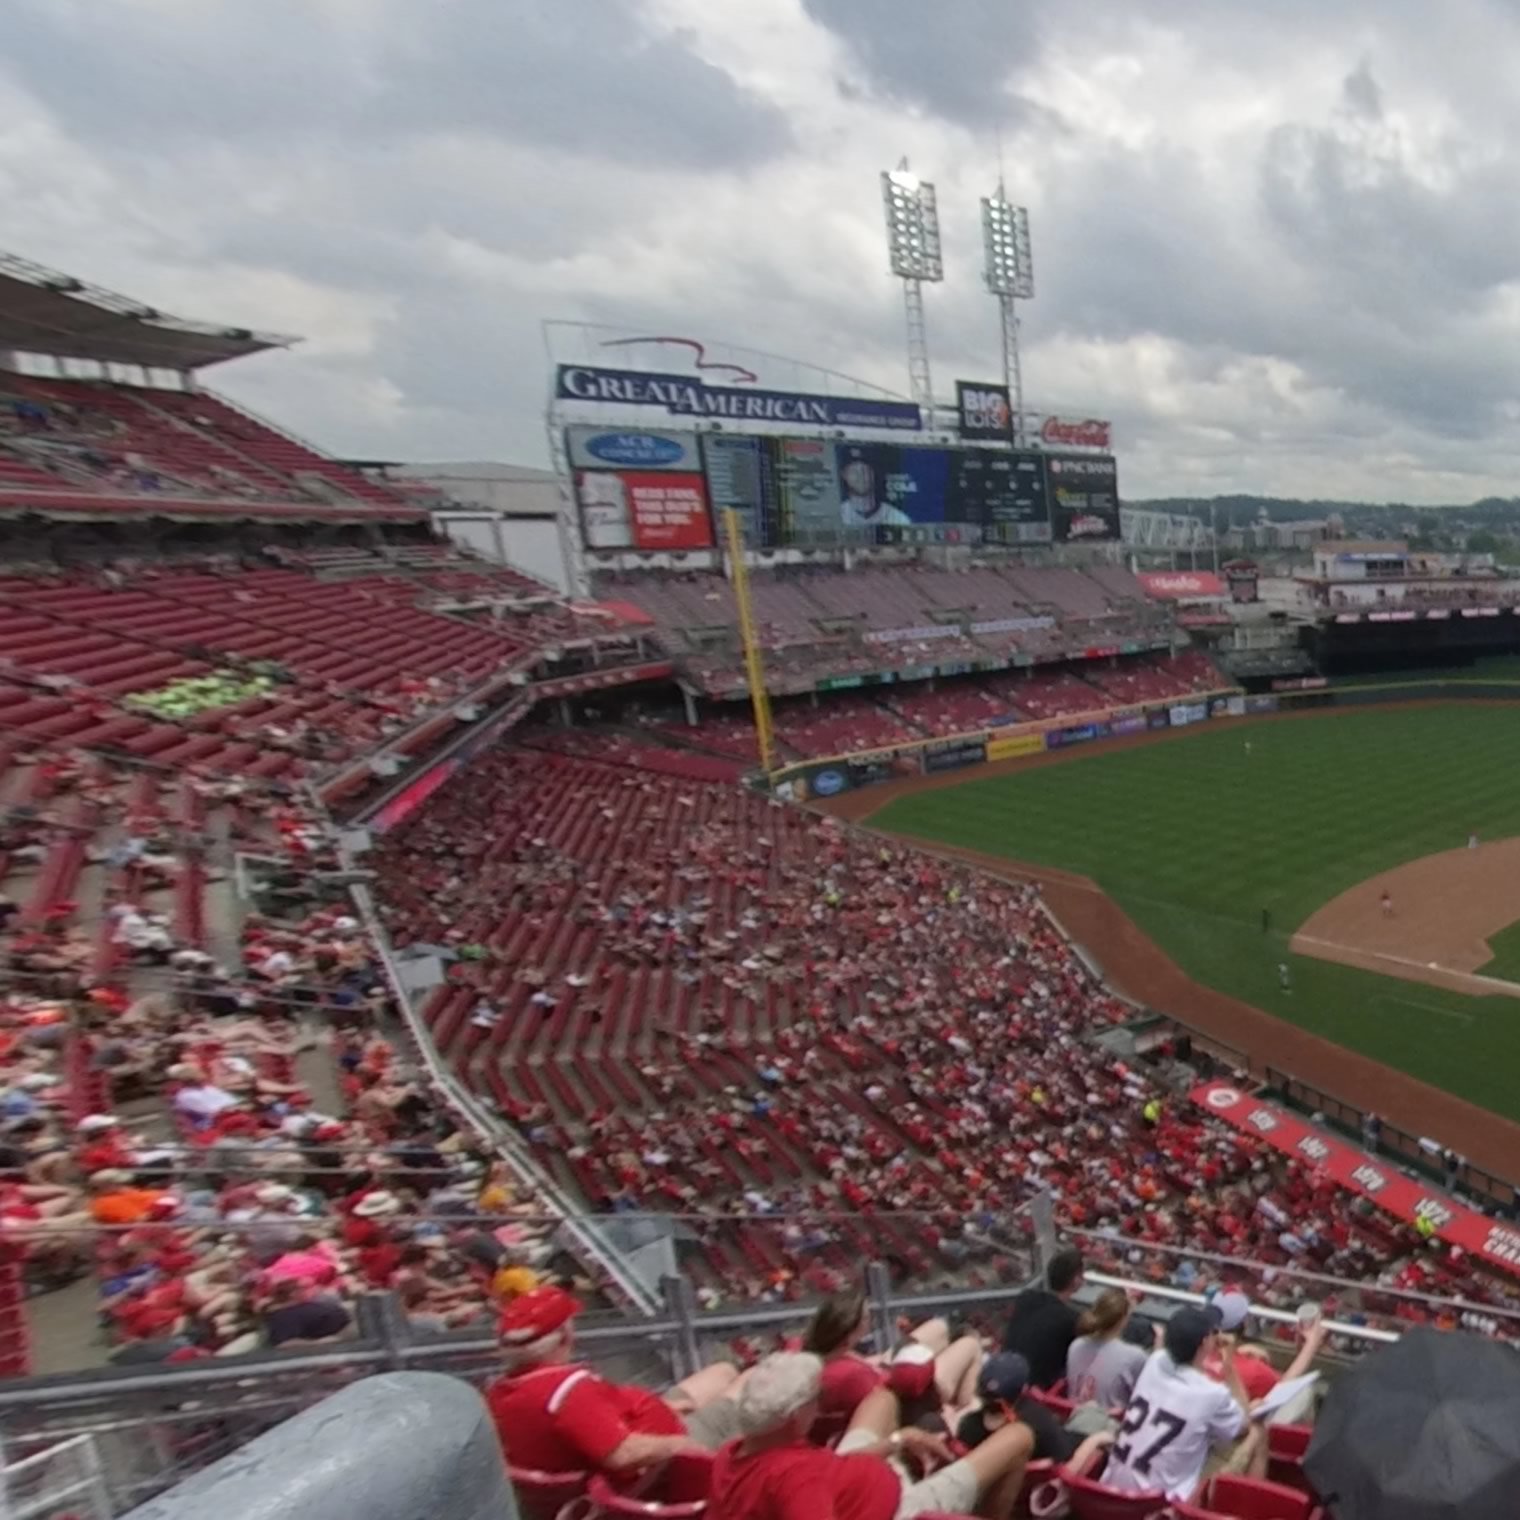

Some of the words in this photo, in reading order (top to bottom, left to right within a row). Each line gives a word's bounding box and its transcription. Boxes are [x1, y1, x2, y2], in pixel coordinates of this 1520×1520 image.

[564, 368, 682, 403] GREAT
[674, 383, 831, 422] AMERICAN
[962, 389, 1004, 411] BIG
[1113, 1395, 1187, 1475] 27
